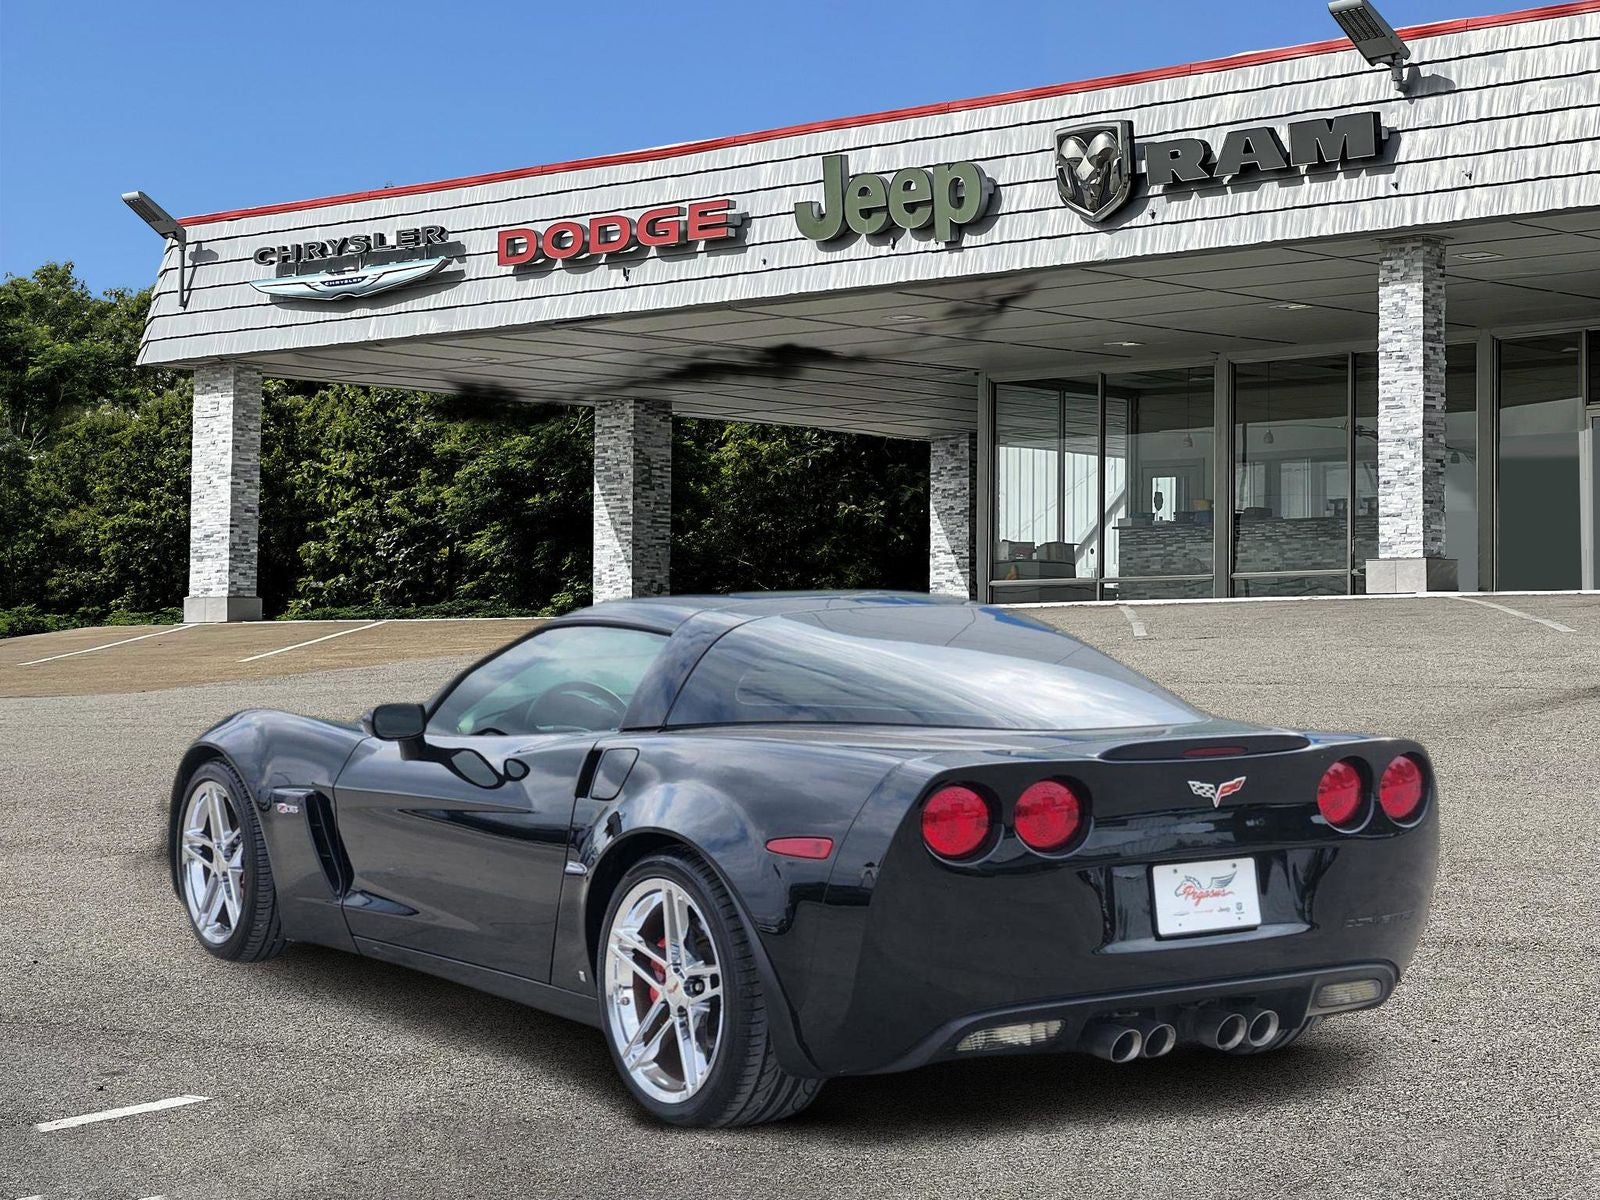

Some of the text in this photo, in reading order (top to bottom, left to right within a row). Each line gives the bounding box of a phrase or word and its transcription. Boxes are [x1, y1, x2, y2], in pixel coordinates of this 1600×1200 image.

[1145, 111, 1380, 186] RAM
[498, 200, 737, 267] DODGE
[794, 154, 987, 242] Jeep
[253, 225, 447, 266] CHRYSLER
